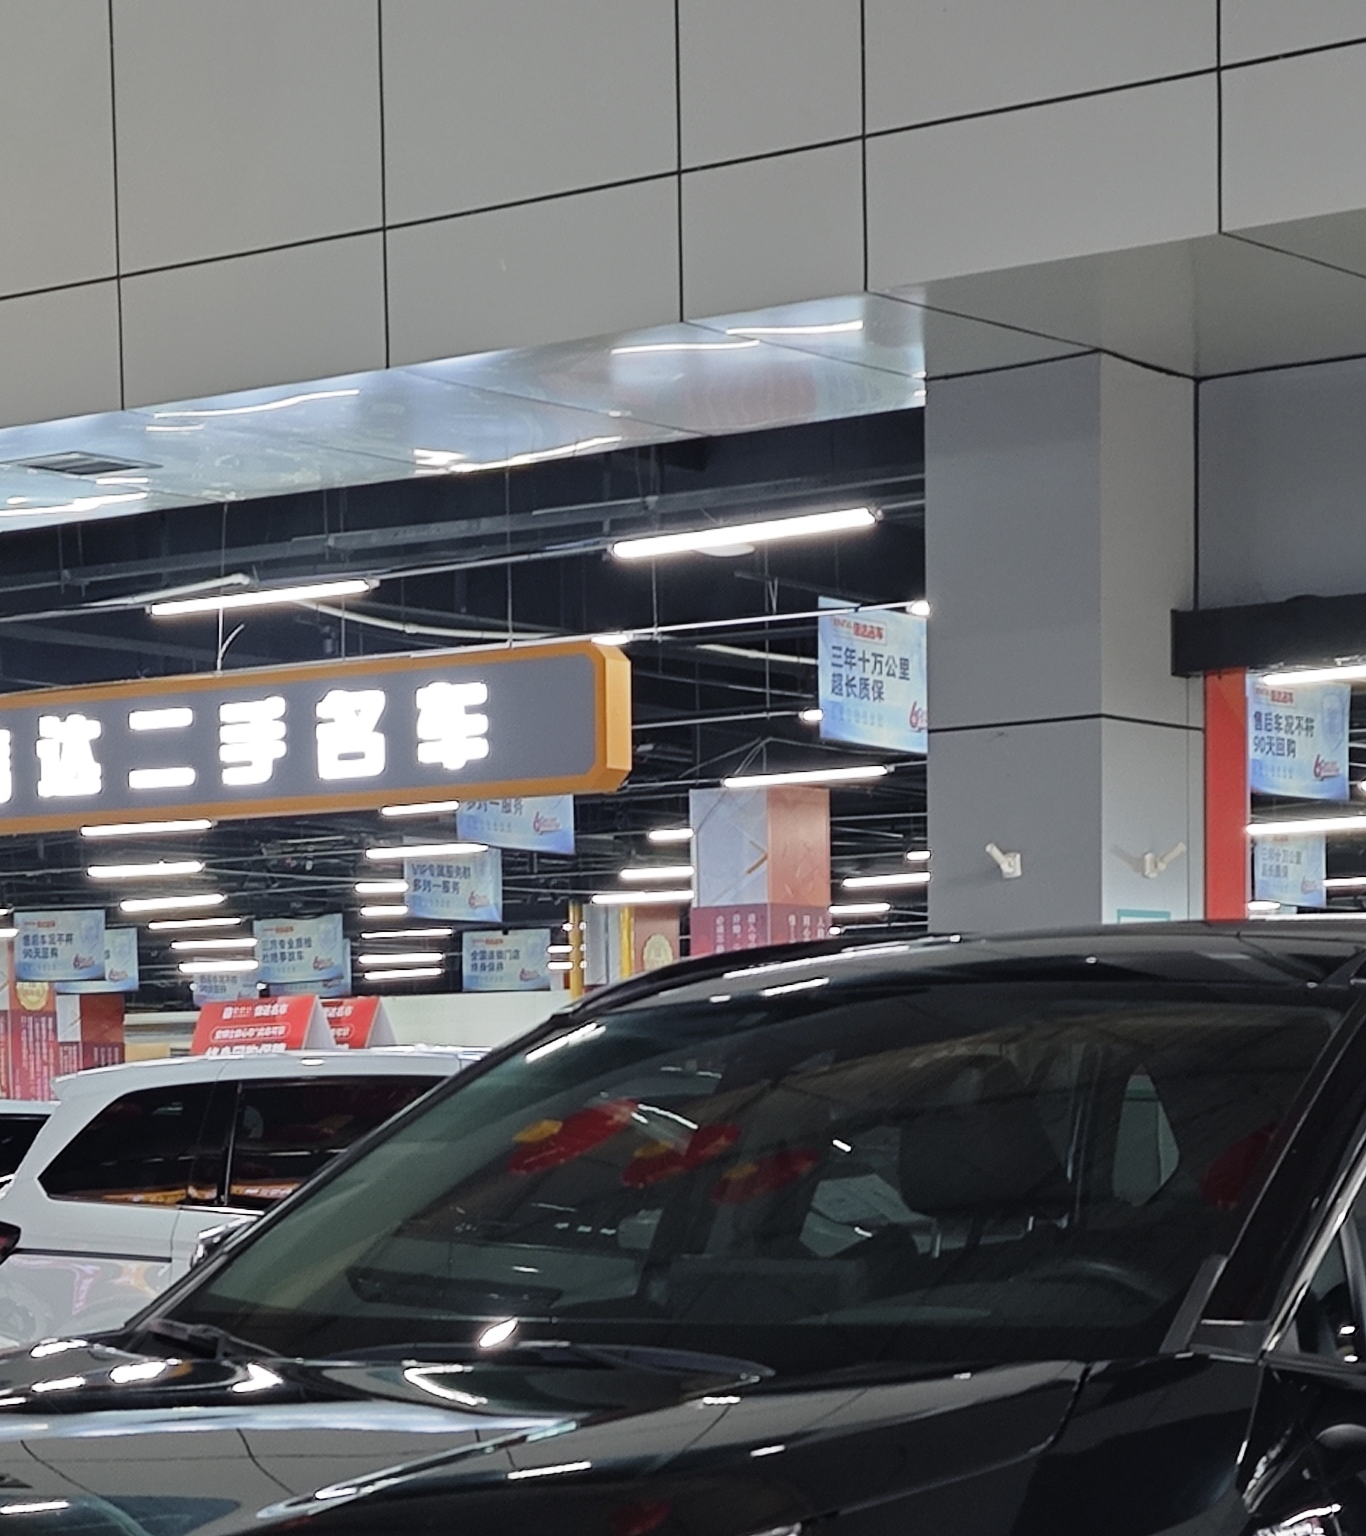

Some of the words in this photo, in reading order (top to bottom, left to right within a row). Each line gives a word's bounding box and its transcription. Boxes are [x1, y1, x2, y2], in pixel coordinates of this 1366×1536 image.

[830, 645, 911, 681] 三年十万公里
[830, 673, 885, 702] 超长质保
[1253, 710, 1315, 738] 售后车况不符
[1253, 735, 1296, 757] 90天回购
